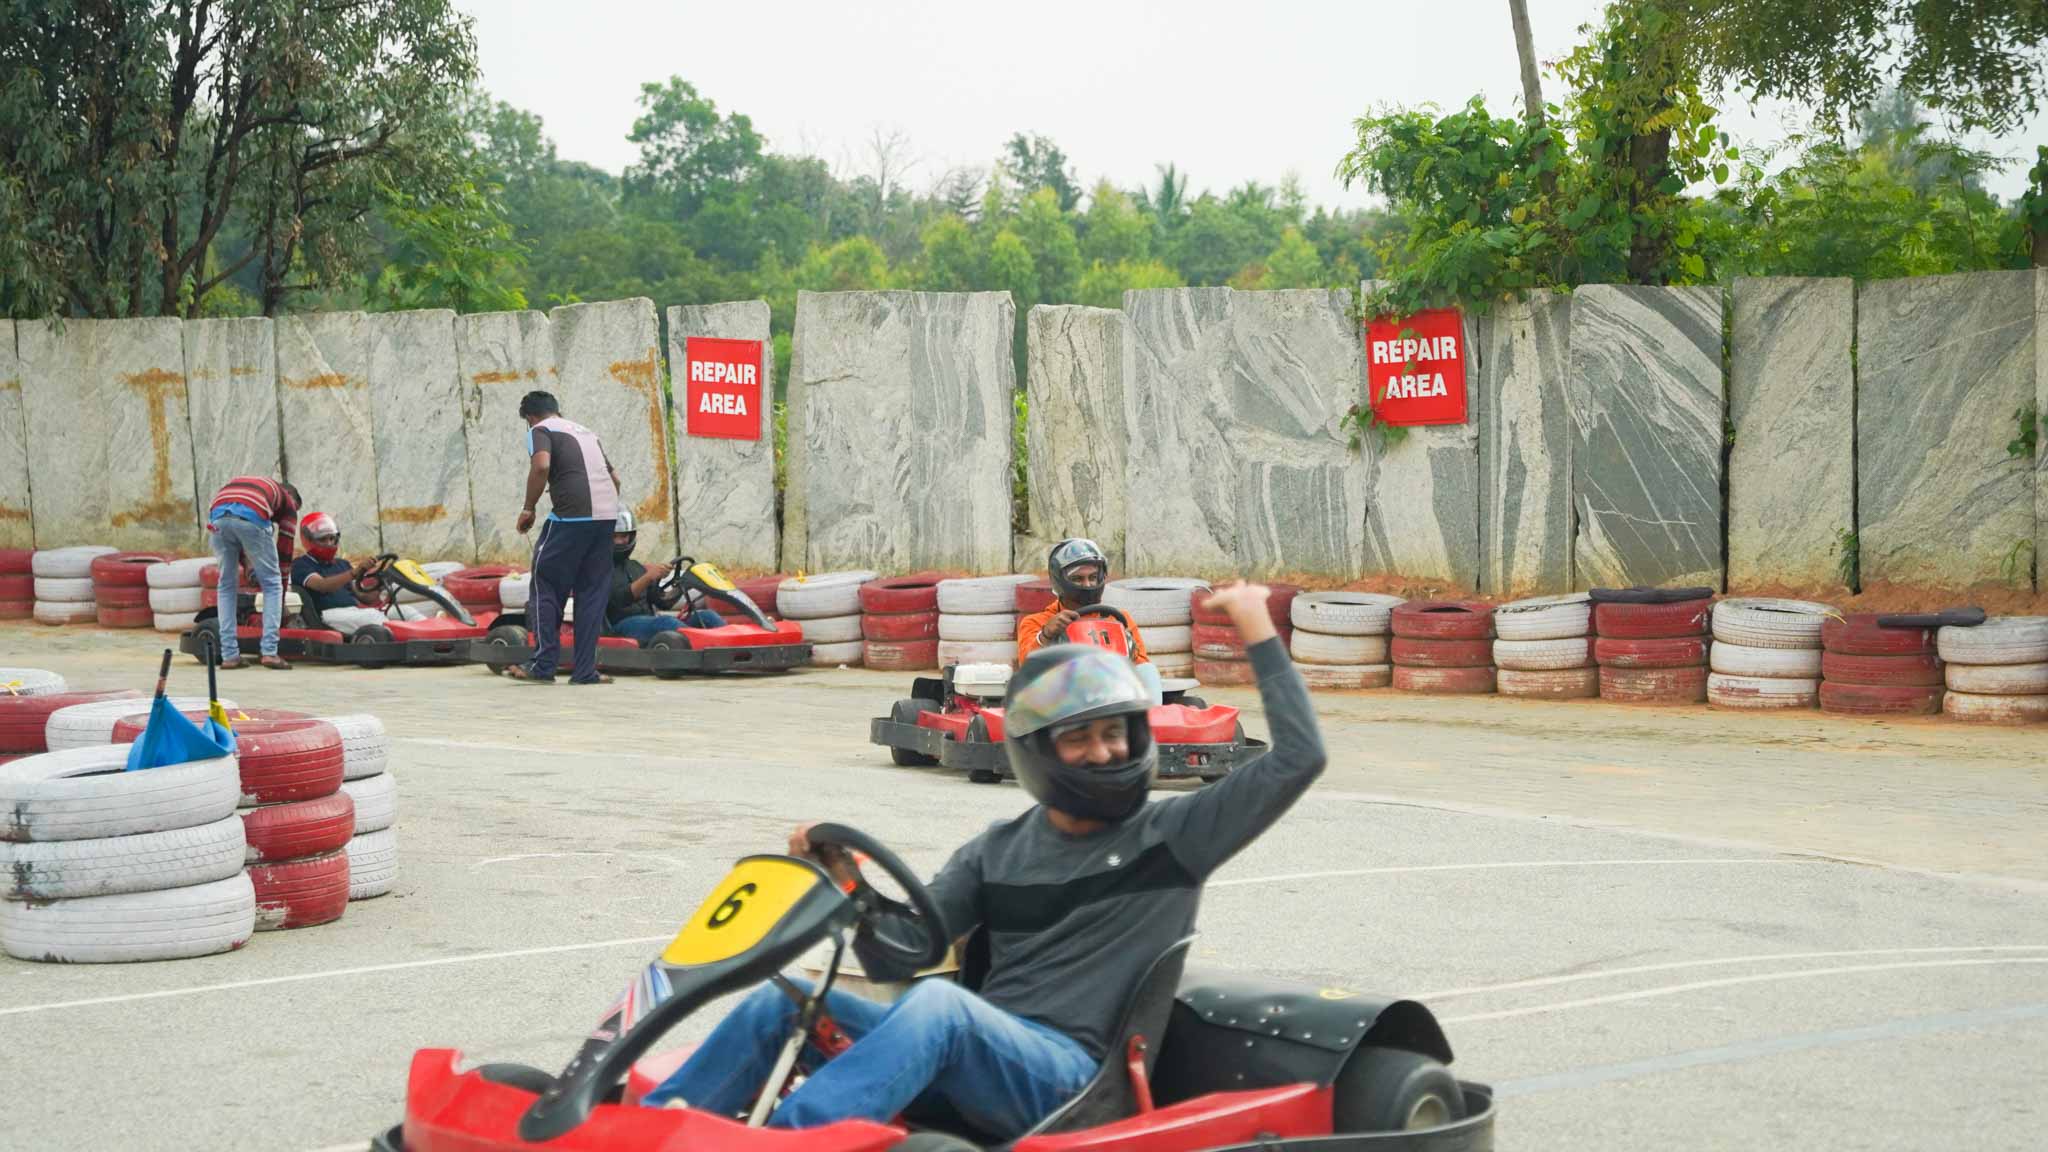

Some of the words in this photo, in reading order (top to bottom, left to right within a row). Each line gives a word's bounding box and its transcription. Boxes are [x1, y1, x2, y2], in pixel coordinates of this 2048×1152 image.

[1373, 336, 1457, 364] REPAIR
[692, 361, 756, 385] REPAIR
[1386, 373, 1448, 399] AREA
[699, 392, 747, 416] AREA
[1088, 629, 1111, 645] 11
[708, 882, 757, 930] 6
